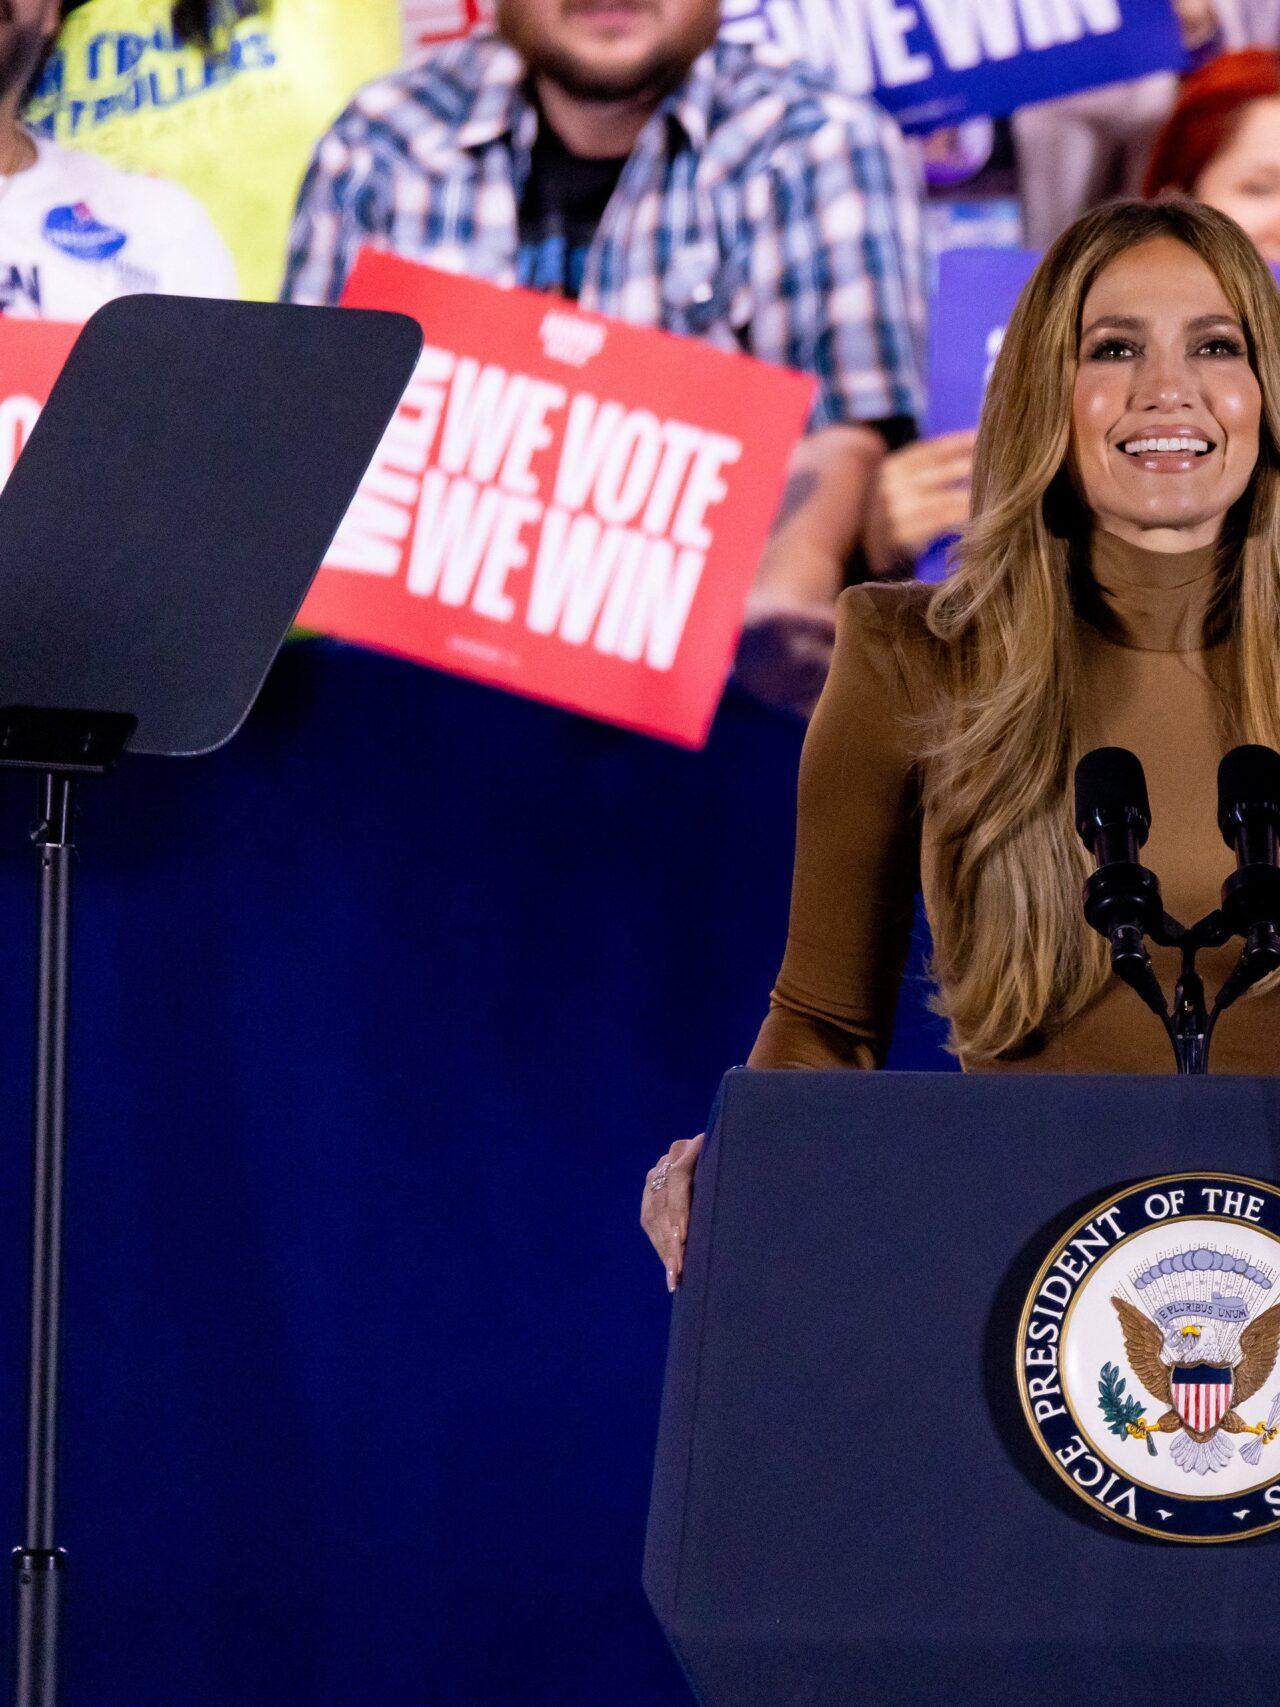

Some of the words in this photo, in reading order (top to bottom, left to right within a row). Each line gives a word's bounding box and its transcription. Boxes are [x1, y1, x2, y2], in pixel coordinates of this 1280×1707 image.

[437, 357, 568, 498] WE
[553, 393, 743, 550] VOTE
[405, 468, 543, 624] WE
[526, 507, 708, 673] WIN
[1144, 1189, 1186, 1220] OF
[1201, 1188, 1265, 1222] THE
[1025, 1206, 1127, 1424] PRESIDENT
[1159, 1310, 1168, 1319] E
[1166, 1302, 1214, 1315] PLURIBUS
[1218, 1308, 1248, 1319] UNUM
[1055, 1435, 1138, 1522] VICE
